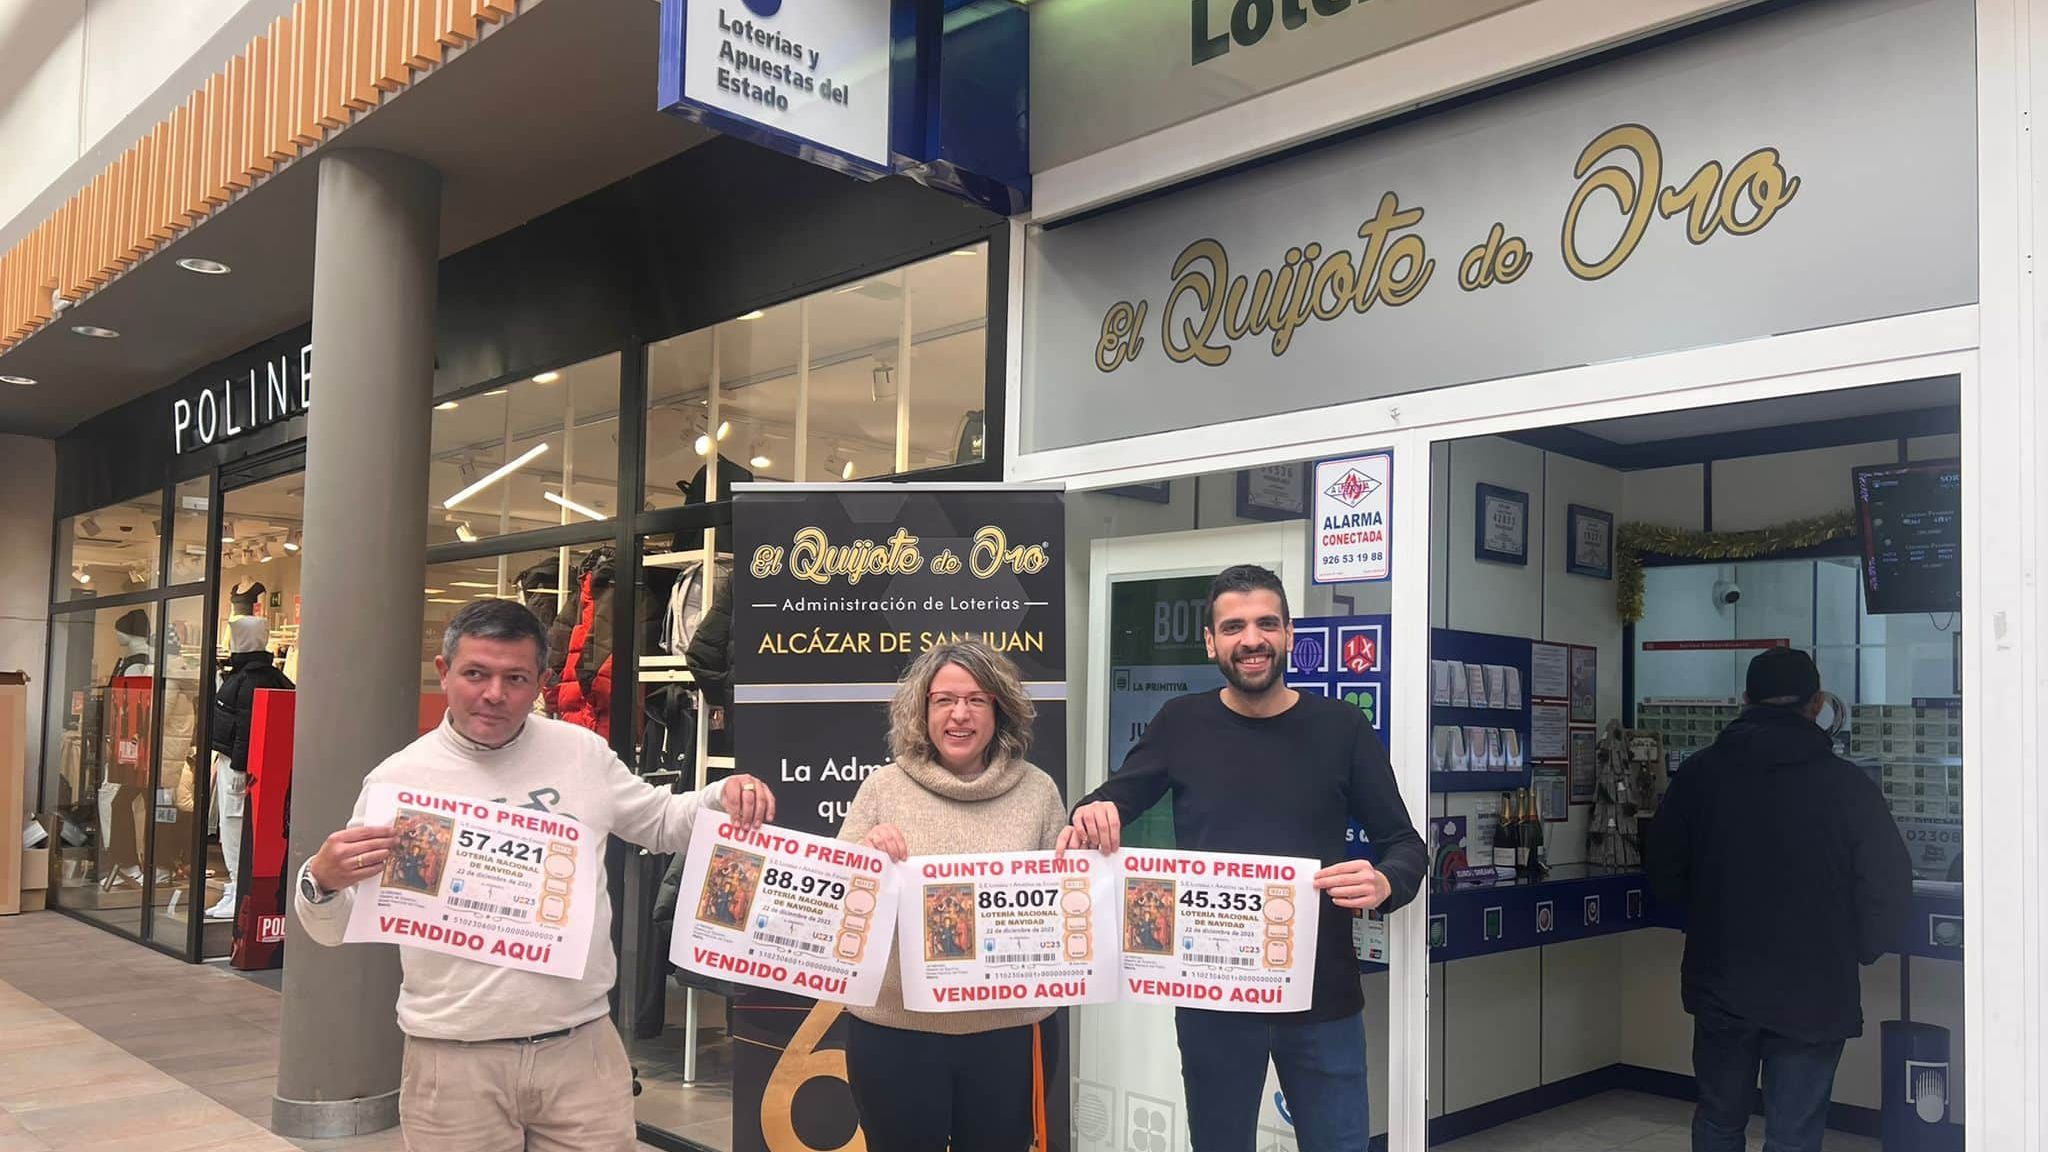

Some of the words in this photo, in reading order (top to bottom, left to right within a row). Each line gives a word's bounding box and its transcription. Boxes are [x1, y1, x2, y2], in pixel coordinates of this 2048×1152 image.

[808, 48, 820, 71] y
[719, 39, 814, 92] Apuestas
[819, 78, 849, 106] del
[717, 67, 789, 112] Estado
[1095, 299, 1148, 374] El
[1162, 191, 1436, 367] Quijote
[1458, 221, 1533, 292] de
[1561, 122, 1801, 281] Oro
[1323, 511, 1382, 530] ALARMA
[1322, 530, 1382, 546] CONECTADA
[750, 545, 784, 578] El
[789, 525, 925, 585] Quijote
[930, 549, 962, 575] de
[969, 525, 1049, 579] Oro
[1322, 555, 1339, 564] 926
[1342, 554, 1354, 563] 53
[1357, 553, 1368, 562] 19
[1371, 552, 1383, 561] 88
[782, 597, 917, 612] Administración
[923, 597, 944, 611] de
[758, 627, 872, 654] ALCÁZAR
[879, 631, 911, 653] DE
[1133, 683, 1144, 691] LA
[1145, 682, 1188, 691] PRIMITIVA
[781, 758, 811, 781] La
[398, 791, 489, 819] QUINTO
[497, 810, 579, 841] PREMIO
[458, 830, 543, 864] 57.421
[718, 822, 799, 854] QUINTO
[804, 843, 883, 873] PREMIO
[456, 849, 494, 863] LOTERÍA
[496, 858, 539, 873] NACIONAL
[486, 865, 523, 878] NAVIDAD
[923, 861, 1004, 878] QUINTO
[1011, 859, 1089, 874] PREMIO
[1124, 856, 1206, 875] QUINTO
[1213, 862, 1296, 881] PREMIO
[475, 871, 508, 882] diciembre
[763, 867, 846, 900] 88.979
[762, 887, 796, 900] LOTERÍA
[799, 895, 840, 910] NACIONAL
[787, 902, 824, 915] NAVIDAD
[978, 889, 1059, 909] 86.007
[1179, 890, 1262, 911] 45.353
[780, 907, 807, 919] diciembre
[808, 914, 816, 922] de
[981, 910, 1015, 918] LOTERÍA
[1017, 909, 1058, 917] NACIONAL
[1181, 910, 1215, 918] LOTERÍA
[1217, 912, 1259, 921] NACIONAL
[1207, 920, 1245, 928] NAVIDAD
[379, 916, 485, 951] VENDIDO
[490, 940, 552, 963] AQUÍ
[693, 946, 787, 981] VENDIDO
[792, 971, 848, 994] AQUÍ
[932, 984, 1027, 1002] VENDIDO
[1034, 978, 1086, 998] AQUÍ
[1128, 978, 1223, 1001] VENDIDO
[1229, 986, 1283, 1004] AQUÍ
